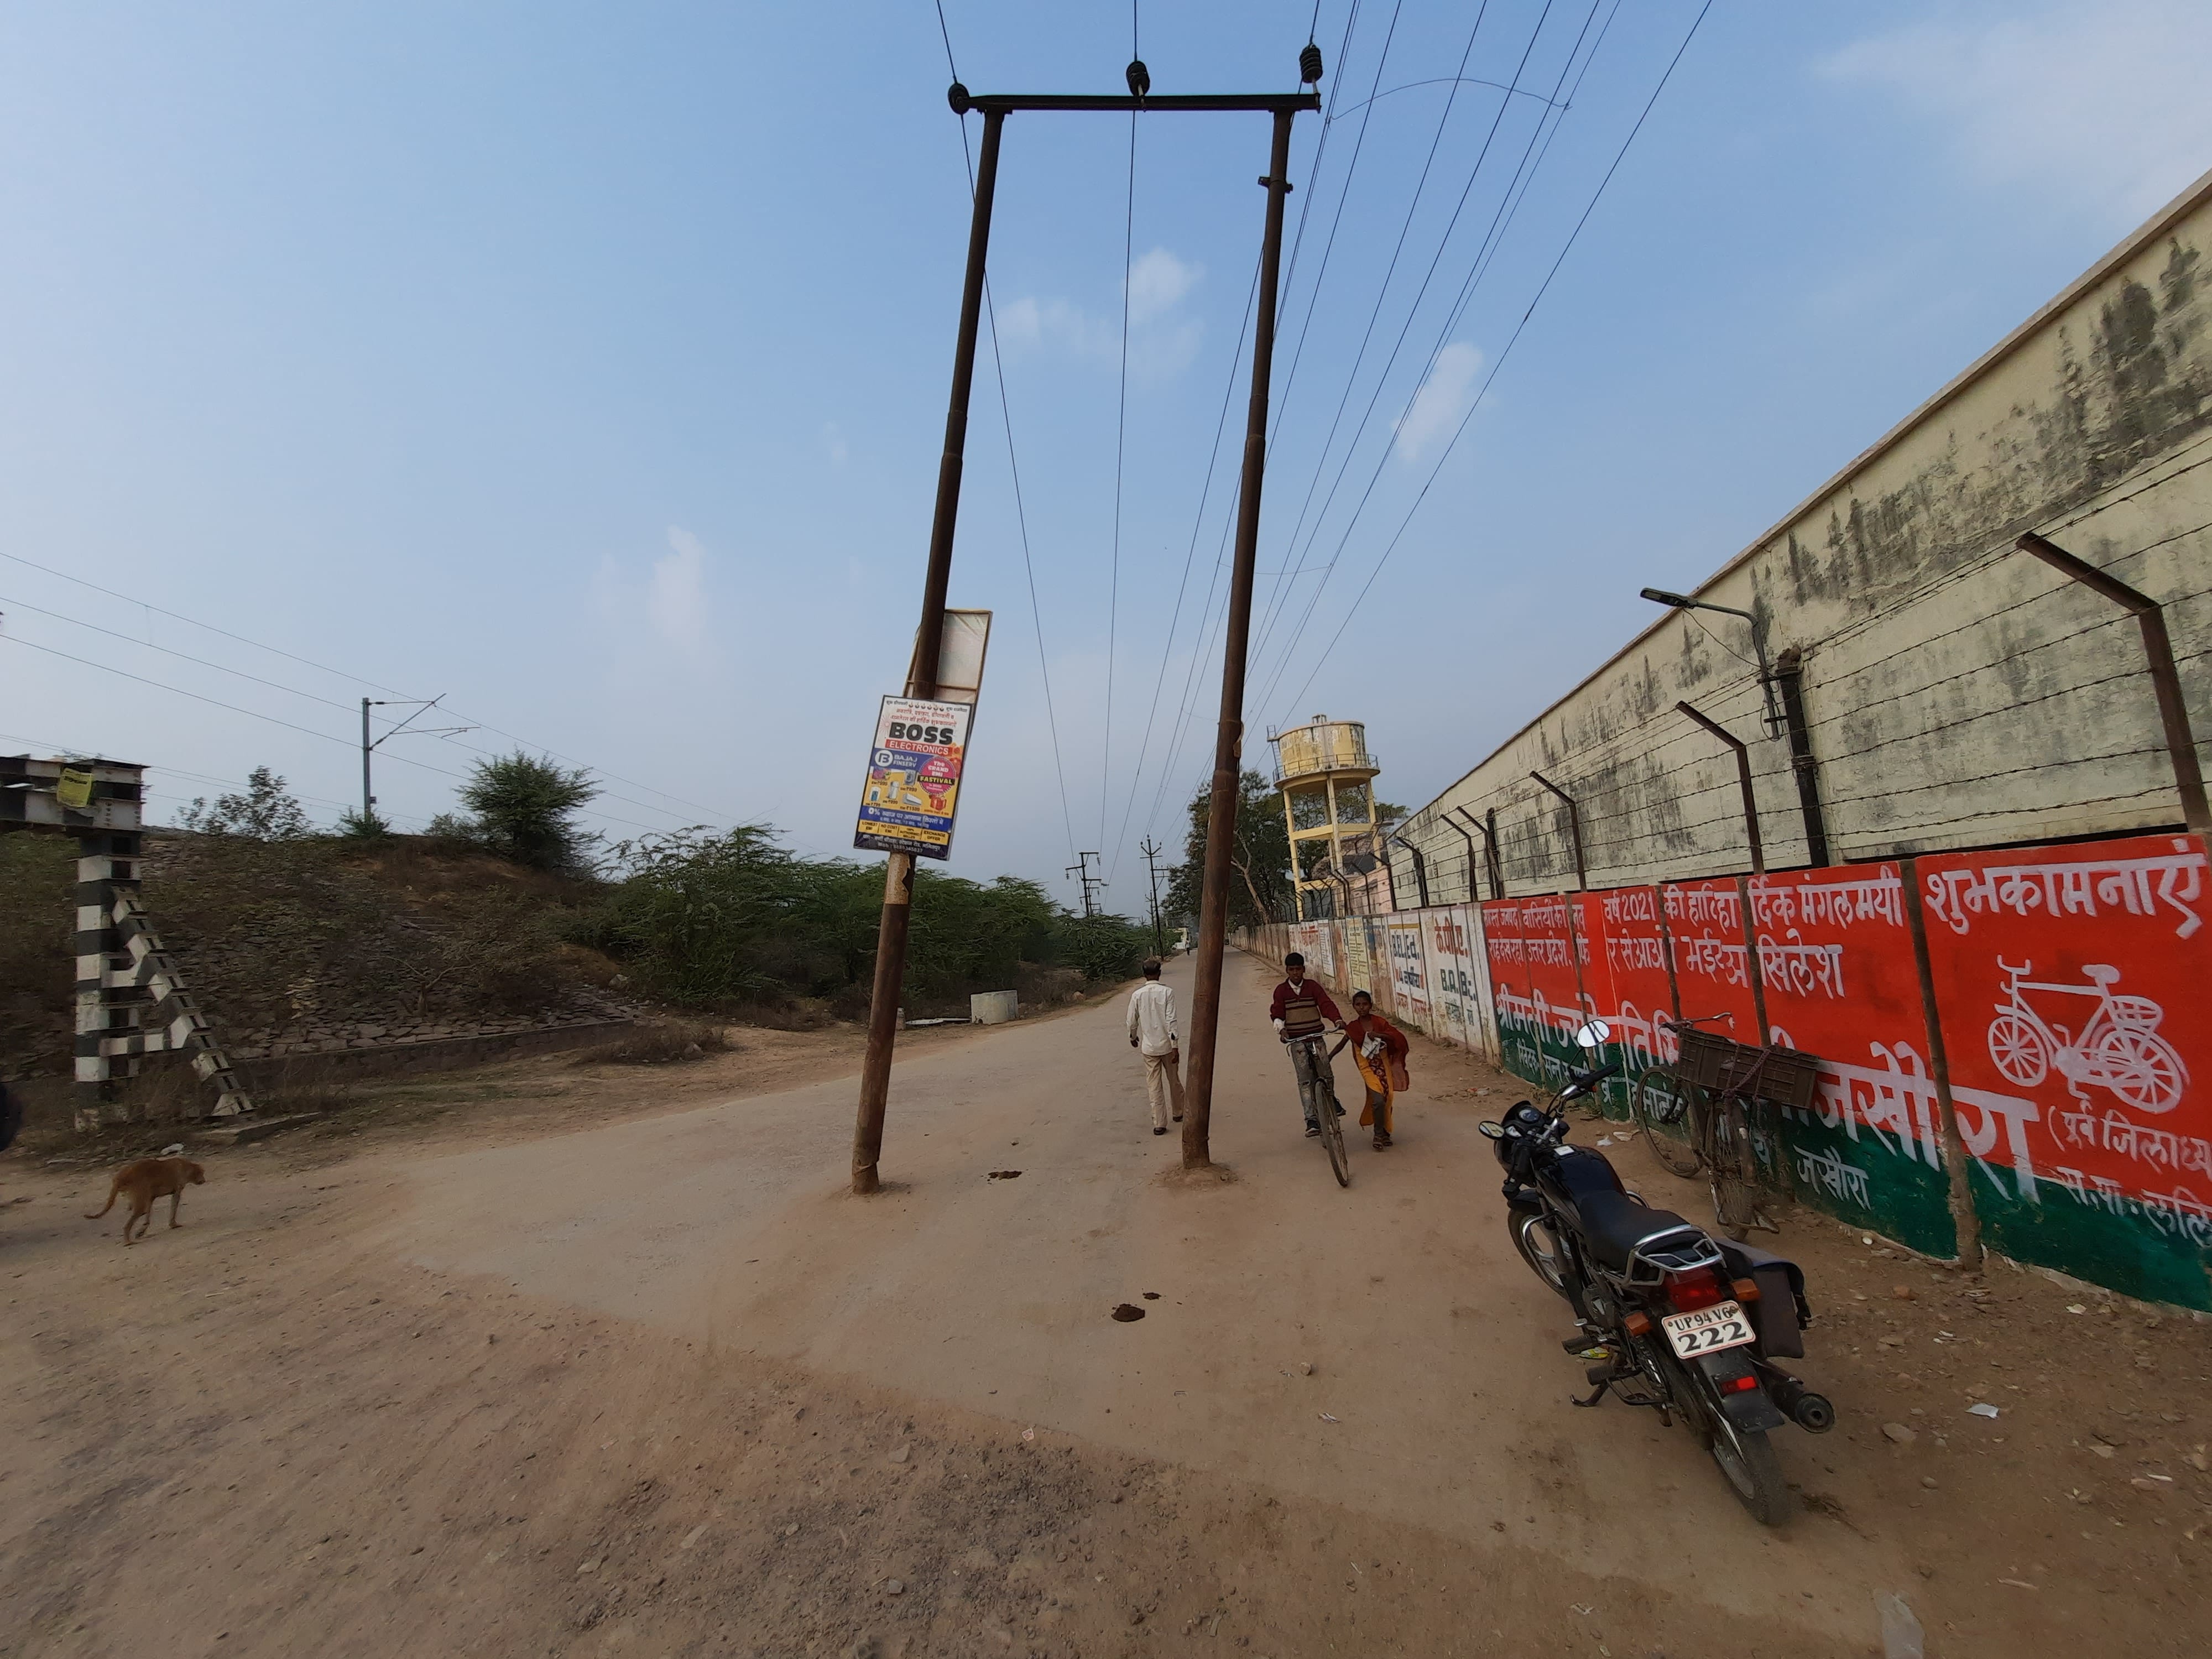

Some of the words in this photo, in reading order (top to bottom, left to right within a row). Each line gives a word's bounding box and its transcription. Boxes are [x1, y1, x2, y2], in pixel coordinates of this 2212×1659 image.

[889, 722, 953, 745] BOSS
[889, 741, 949, 755] ELECTRONICS
[893, 759, 917, 768] FINSERV
[894, 754, 917, 763] BAJAJ
[920, 776, 952, 785] FASTIVAL
[1603, 890, 1621, 924] वर्ष
[1622, 891, 1657, 921] 2021
[1663, 884, 1686, 920] की
[1924, 838, 2206, 940] शुभकामनाएं
[1677, 1321, 1747, 1353] 222
